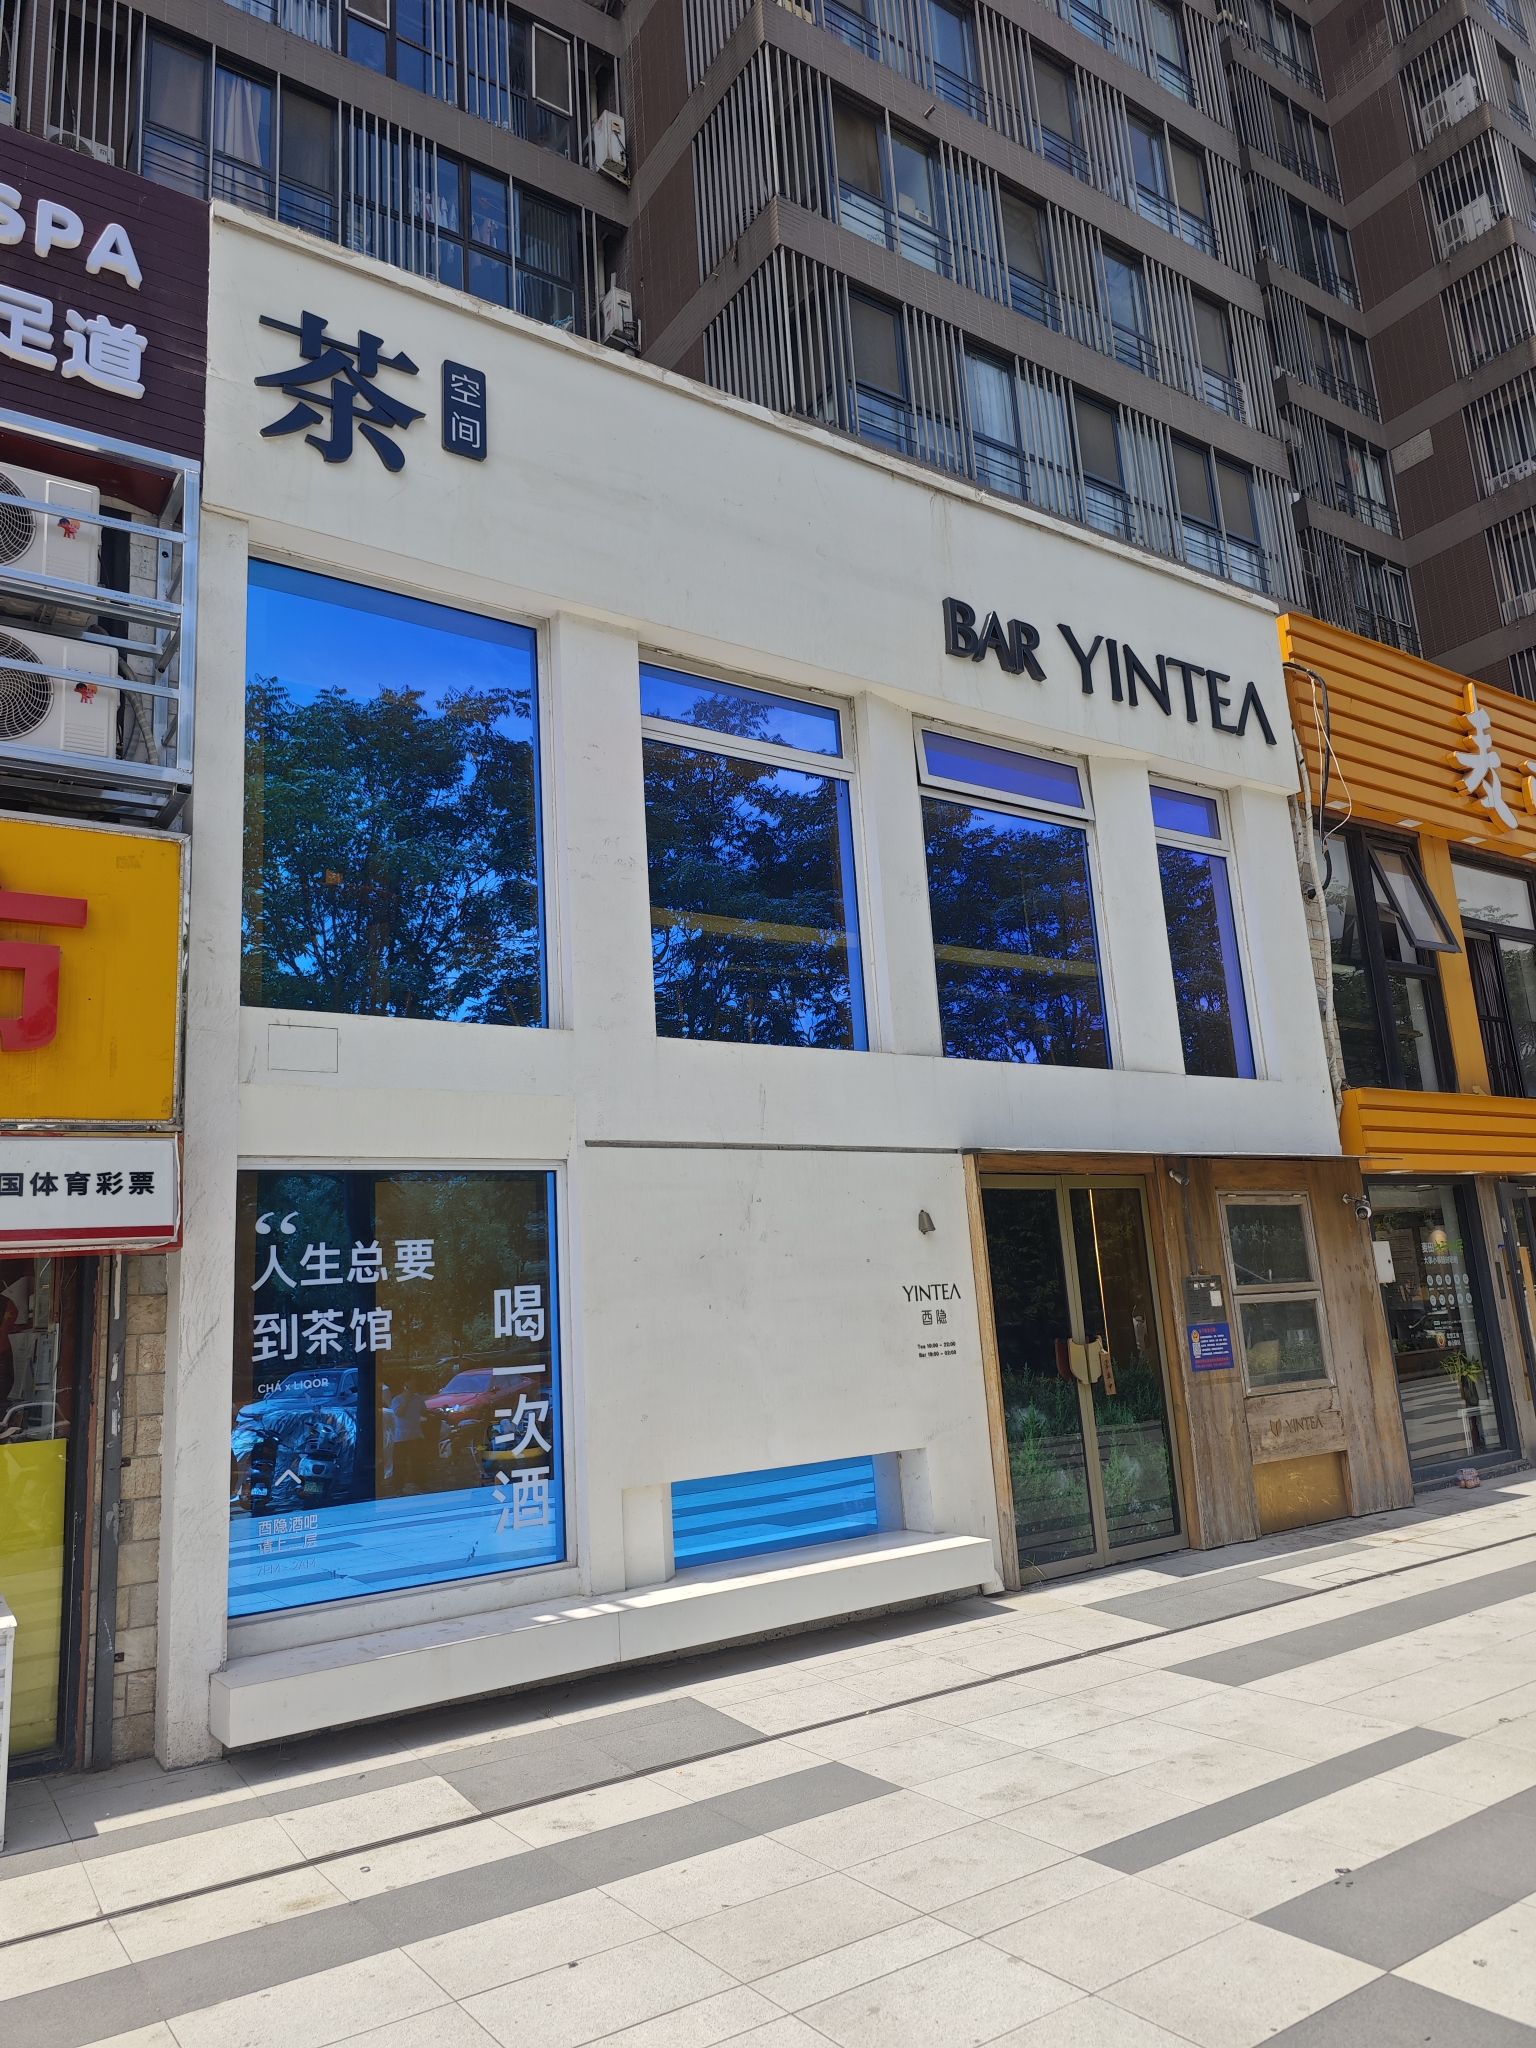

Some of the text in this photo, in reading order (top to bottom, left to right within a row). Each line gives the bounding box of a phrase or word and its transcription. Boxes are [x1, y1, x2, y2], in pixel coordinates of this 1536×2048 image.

[254, 310, 427, 473] 茶
[450, 372, 482, 449] 空间
[942, 596, 1277, 745] BAR YINTEA
[250, 1238, 436, 1292] 人生总要
[902, 1283, 961, 1302] YINTEA
[251, 1306, 393, 1363] 到茶馆
[492, 1284, 552, 1537] 喝一次酒
